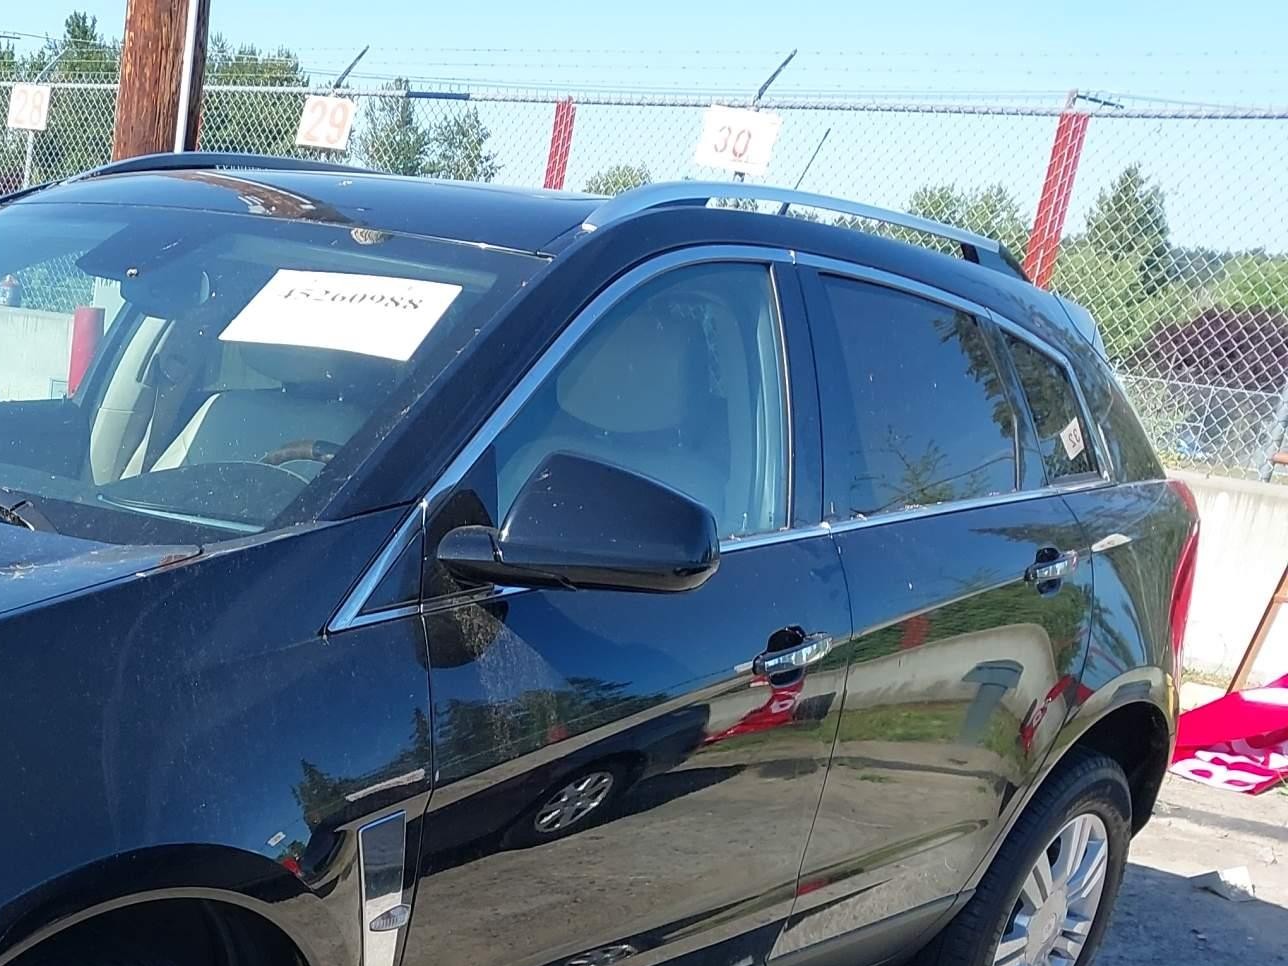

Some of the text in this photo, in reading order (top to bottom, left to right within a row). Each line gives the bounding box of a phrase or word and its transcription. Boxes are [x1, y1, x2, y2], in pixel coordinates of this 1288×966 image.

[14, 88, 44, 126] 28
[303, 100, 350, 145] 29
[713, 125, 752, 158] 30
